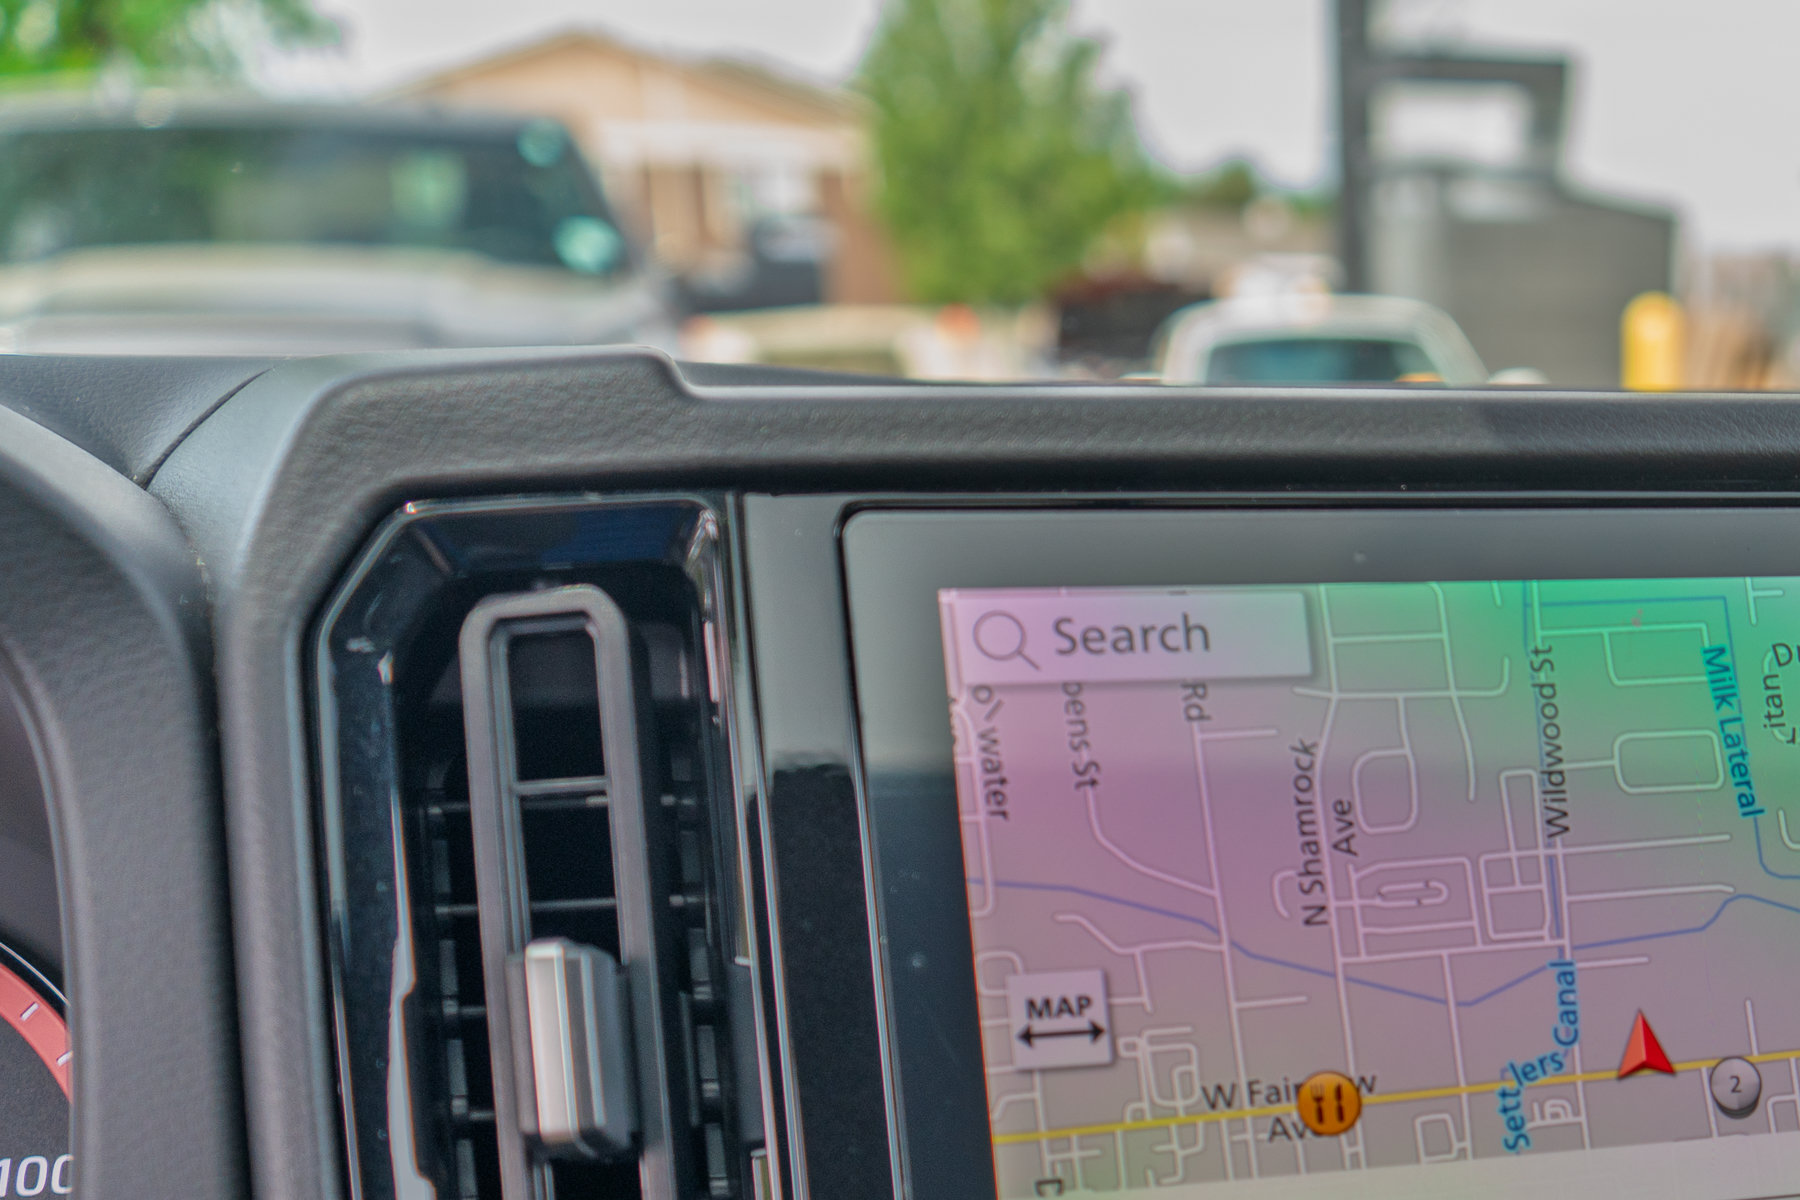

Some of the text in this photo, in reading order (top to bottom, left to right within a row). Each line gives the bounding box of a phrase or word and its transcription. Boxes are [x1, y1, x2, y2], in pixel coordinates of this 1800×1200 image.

[1053, 614, 1210, 657] Search
[1530, 645, 1570, 838] Wildwood St
[1702, 644, 1764, 817] Milk Lateral
[1072, 760, 1100, 790] St
[1289, 739, 1328, 926] N Shamrock
[1332, 798, 1358, 857] Ave
[1026, 996, 1092, 1020] MAP
[1549, 959, 1577, 1045] Canal
[1202, 1084, 1237, 1110] W
[1730, 1075, 1742, 1092] 2
[1268, 1117, 1320, 1143] Av
